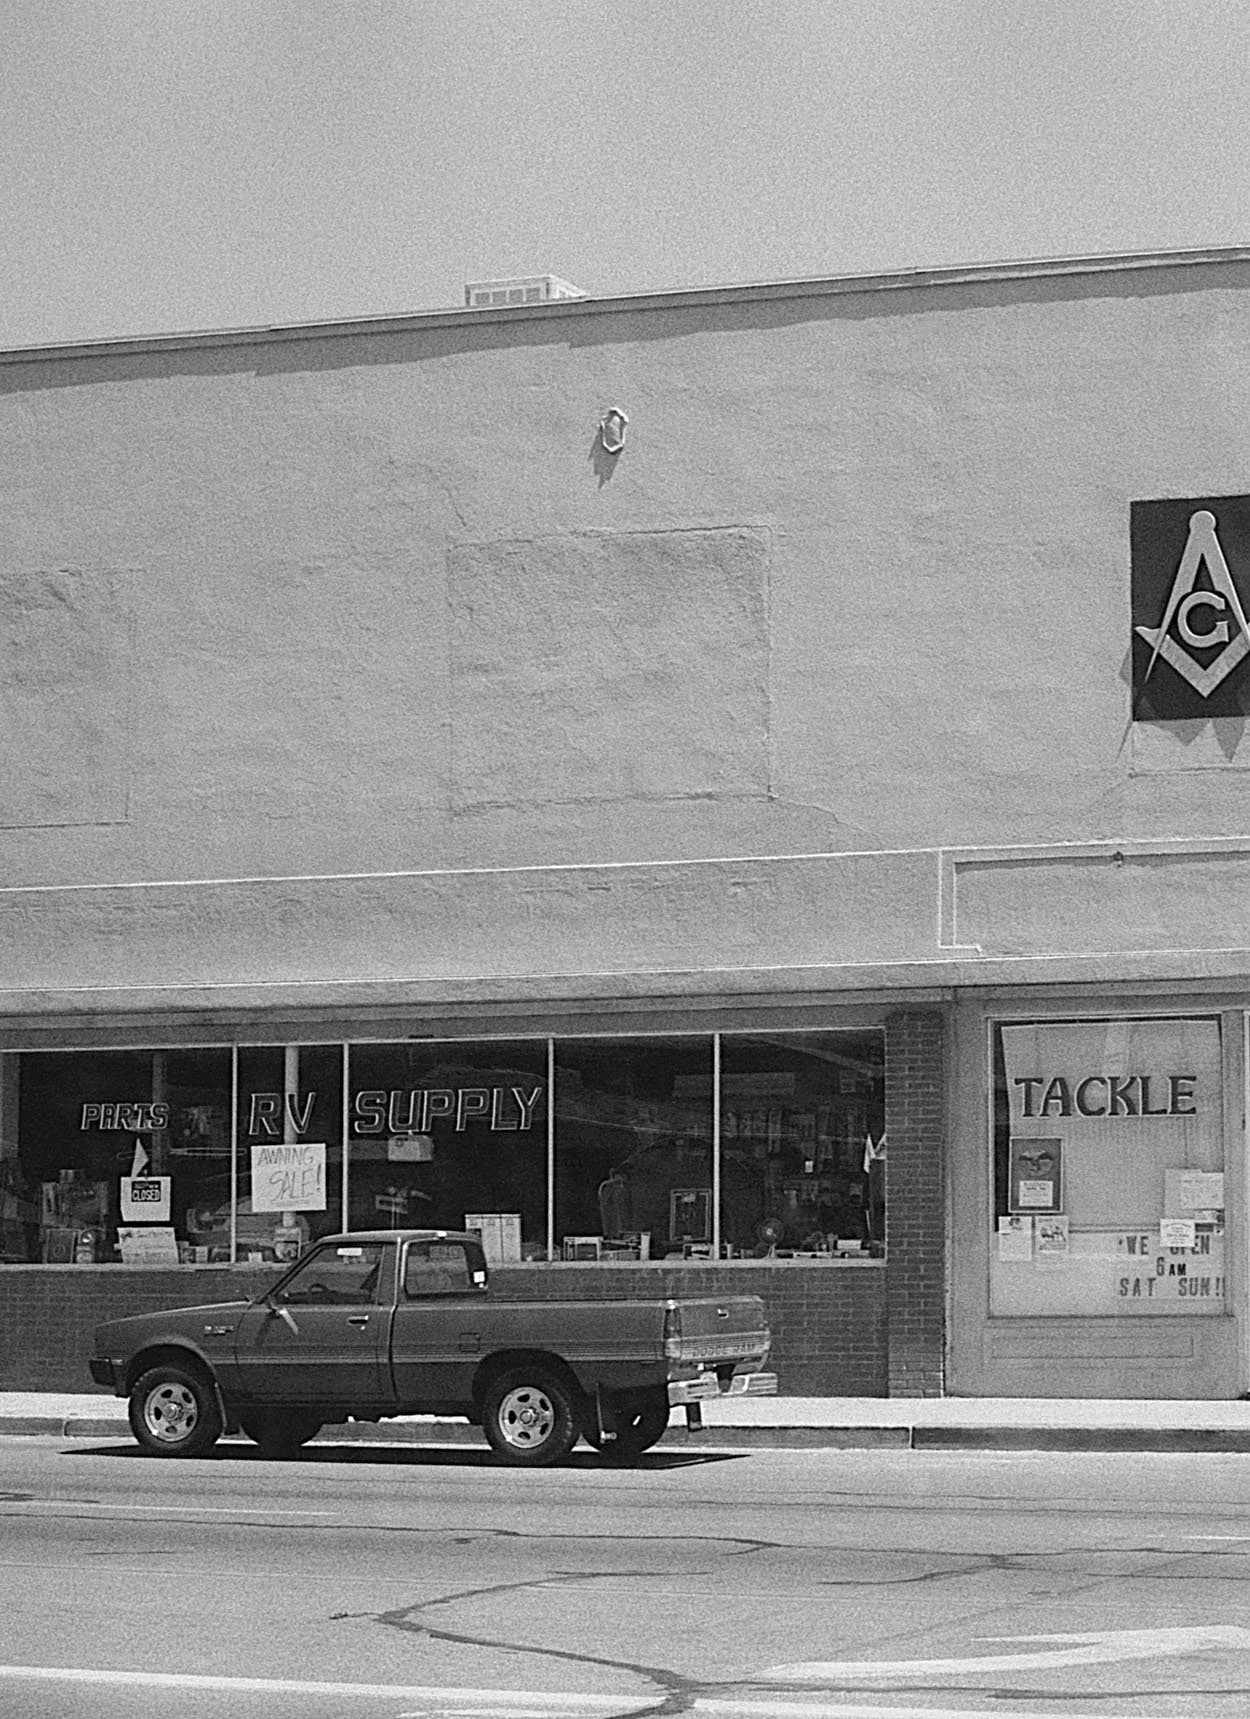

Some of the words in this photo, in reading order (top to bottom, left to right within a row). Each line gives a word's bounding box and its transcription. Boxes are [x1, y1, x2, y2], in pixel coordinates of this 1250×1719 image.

[1177, 590, 1229, 648] G
[1014, 1074, 1198, 1118] TACKLE
[81, 1103, 169, 1130] PARTS
[249, 1092, 316, 1135] RV
[354, 1086, 543, 1134] SUPPLY
[257, 1146, 314, 1166] AWNING
[132, 1189, 160, 1202] CLOSED
[268, 1163, 322, 1202] SALE!
[1156, 1256, 1165, 1277] 6
[1169, 1263, 1187, 1276] AM
[1119, 1277, 1157, 1297] SAT
